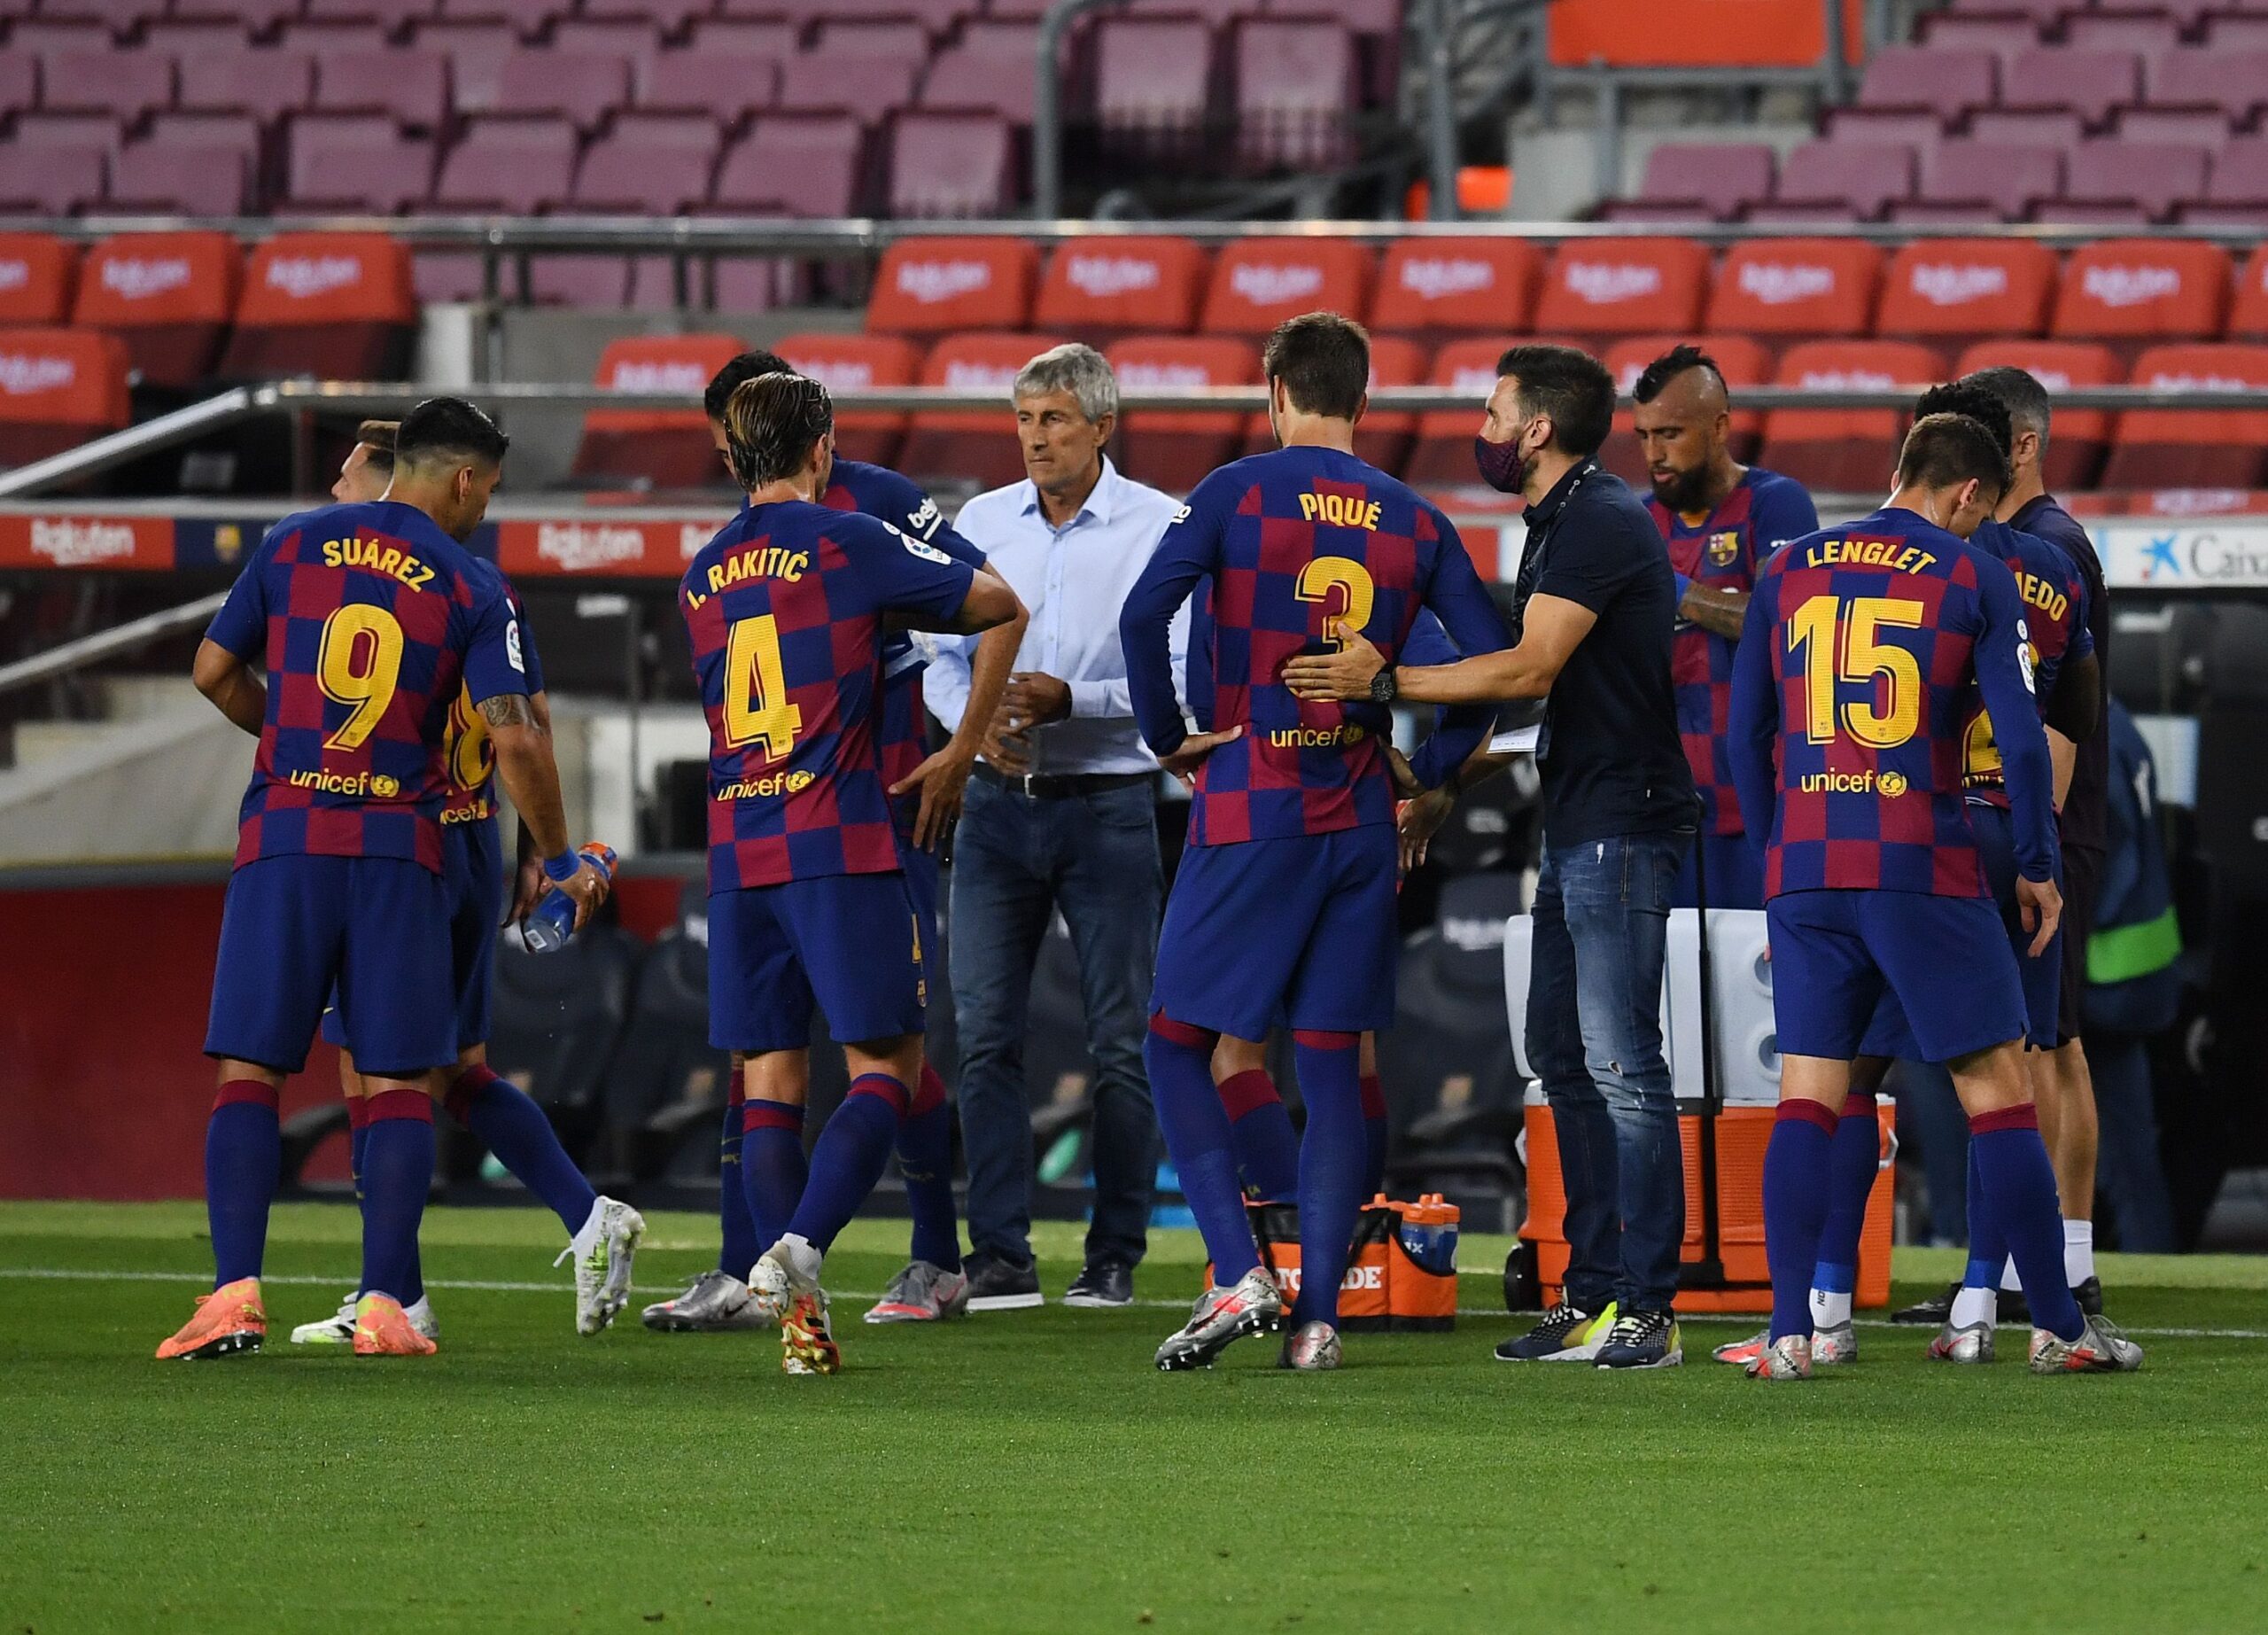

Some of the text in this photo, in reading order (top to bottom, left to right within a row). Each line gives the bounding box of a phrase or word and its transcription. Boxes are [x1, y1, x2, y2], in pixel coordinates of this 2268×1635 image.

[1298, 493, 1382, 532] PIQUÉ
[322, 537, 436, 593] SUÁREZ
[707, 548, 810, 594] RAKITIĆ
[1806, 541, 1937, 575] LENGLET
[316, 603, 405, 752] 9
[722, 613, 803, 764] 4
[1787, 596, 1925, 749] 15
[1270, 722, 1345, 749] unicef
[290, 767, 369, 797] unicef
[717, 772, 785, 801] unicef
[1800, 767, 1874, 793] unicef
